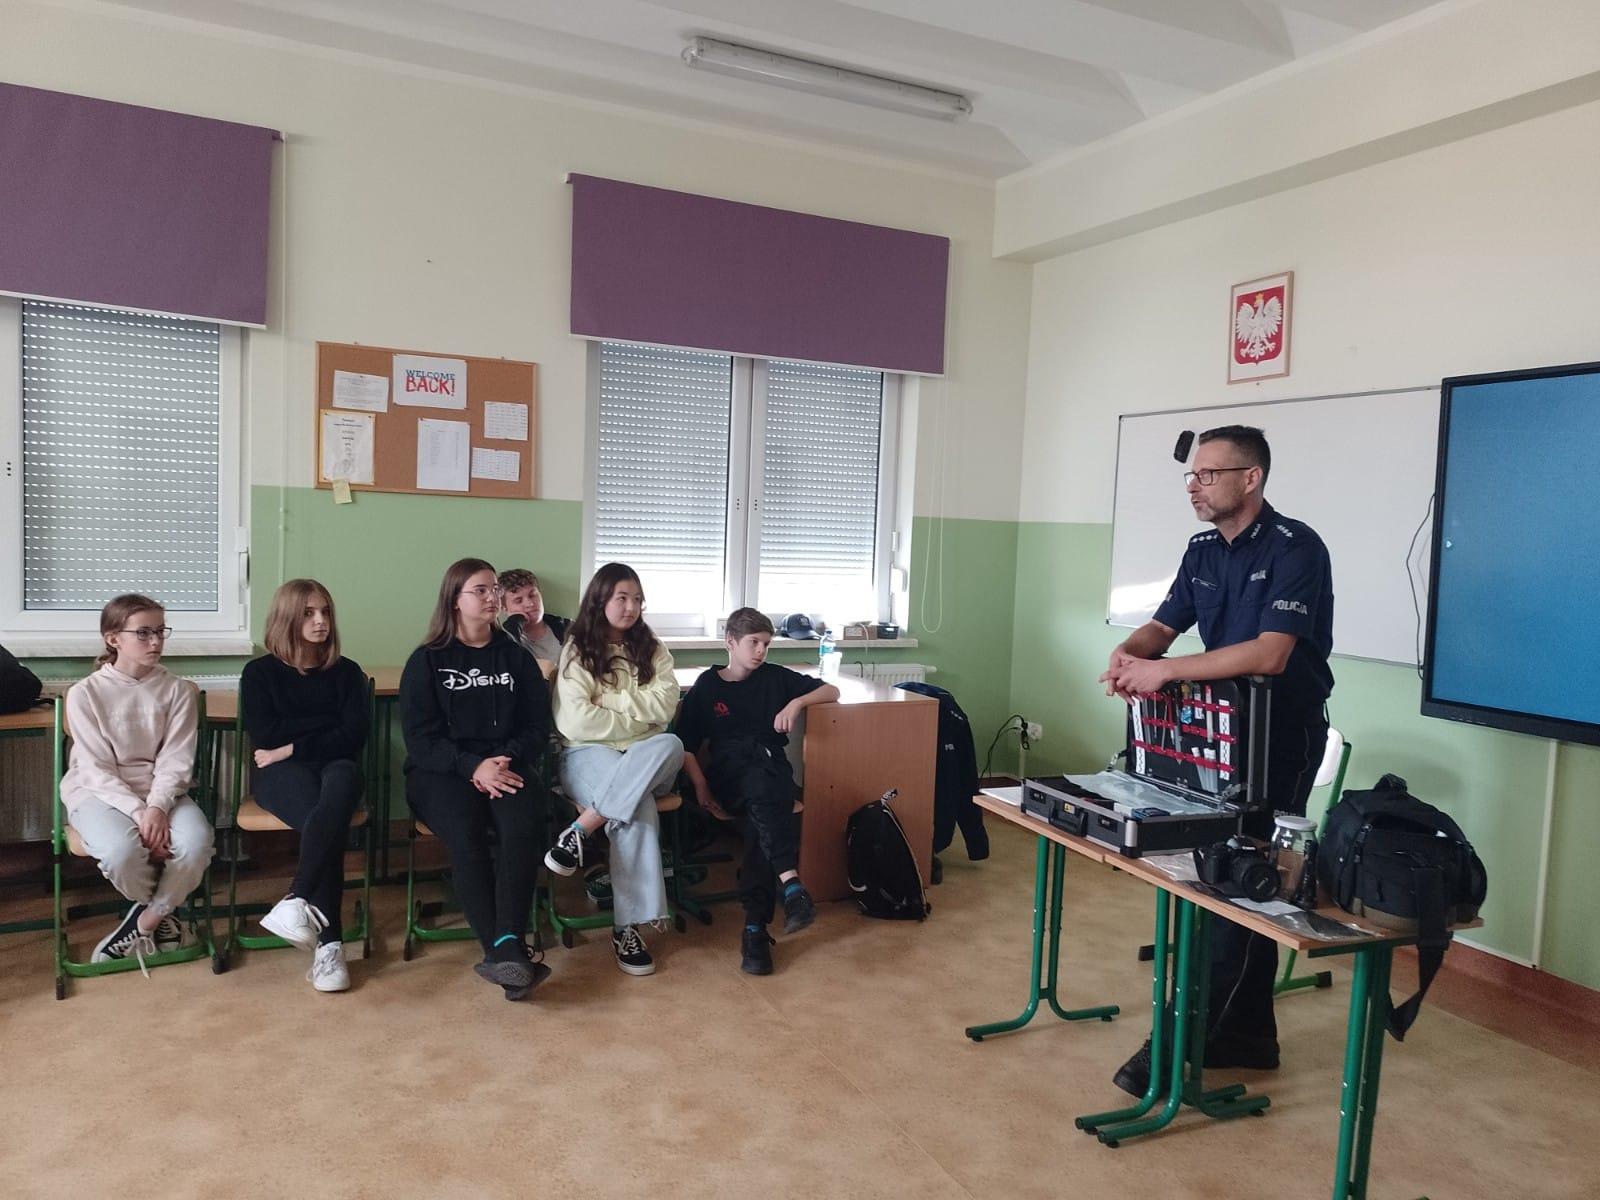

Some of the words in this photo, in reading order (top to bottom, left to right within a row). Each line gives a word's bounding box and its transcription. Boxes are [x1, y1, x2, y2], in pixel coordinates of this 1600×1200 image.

[405, 369, 455, 380] WELCOME
[405, 376, 455, 397] BACK!
[1272, 600, 1308, 615] POLICJA
